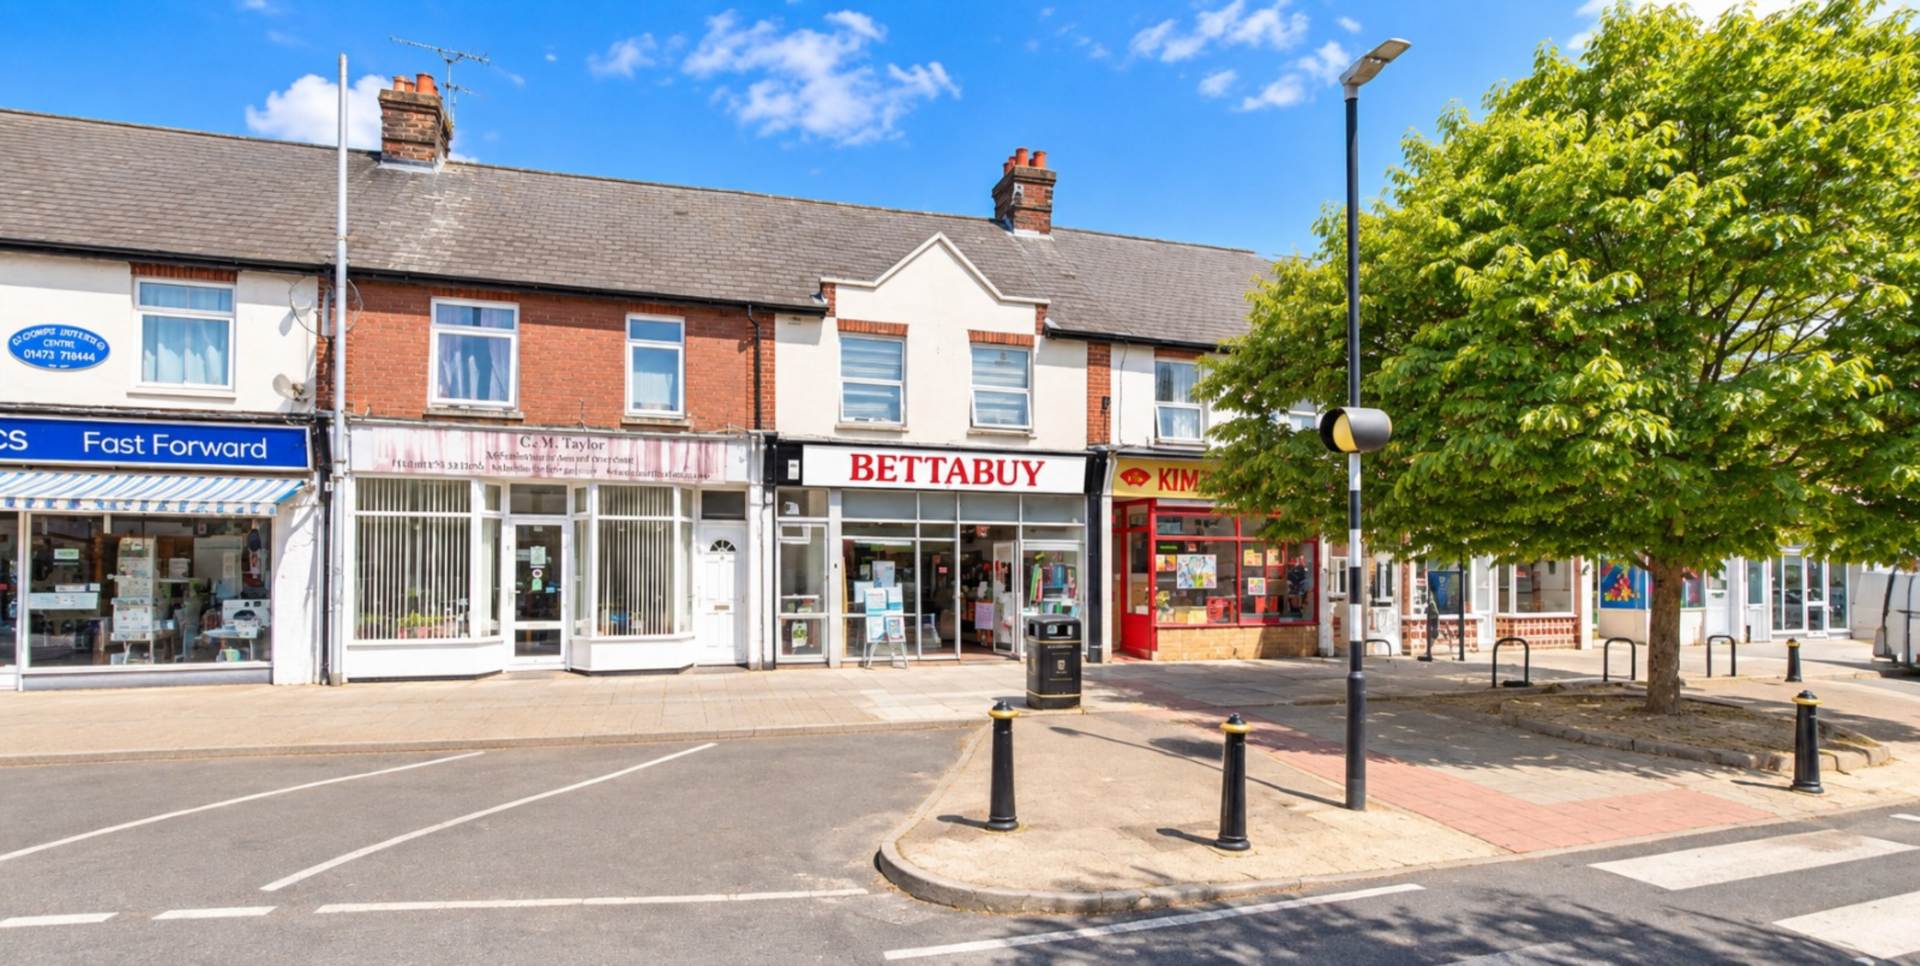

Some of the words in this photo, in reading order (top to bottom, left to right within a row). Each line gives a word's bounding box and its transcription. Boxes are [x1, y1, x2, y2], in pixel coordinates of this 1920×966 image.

[24, 349, 55, 360] 01473
[83, 431, 146, 455] Fast
[152, 433, 268, 460] Forward
[562, 436, 605, 452] Taylor
[849, 453, 1045, 487] BETTABUY
